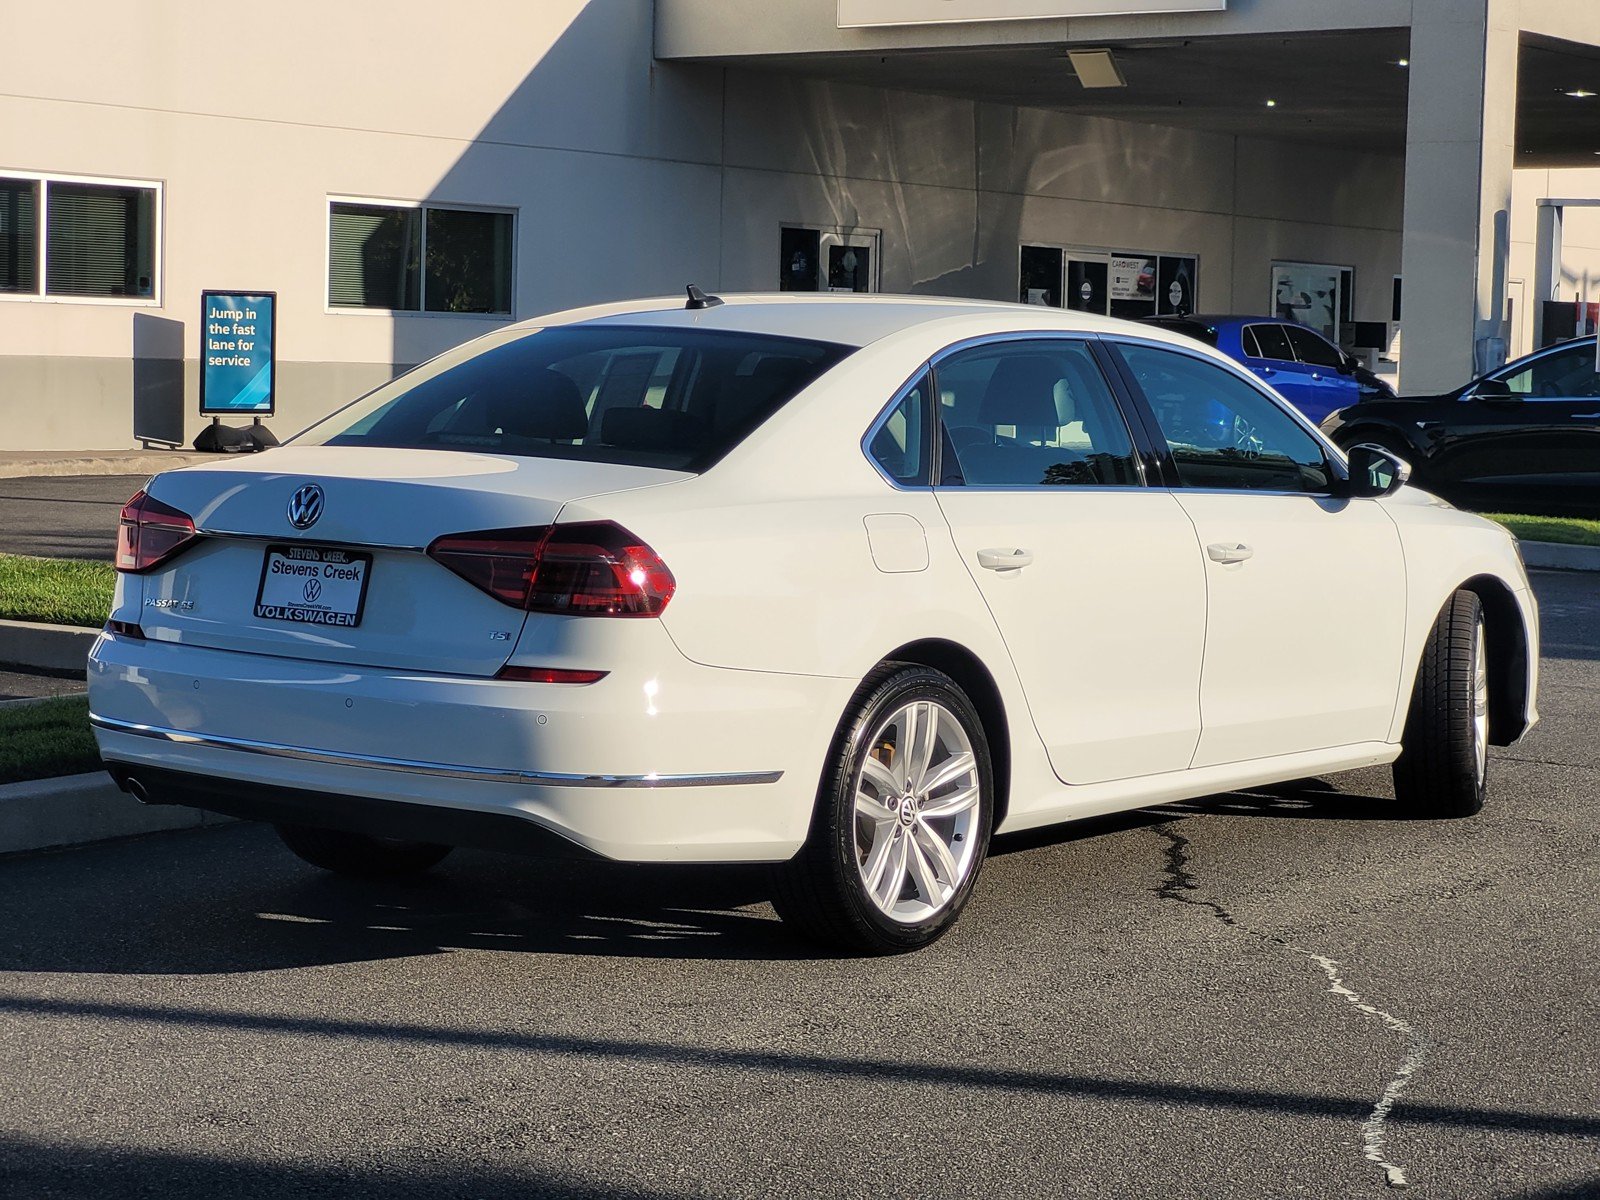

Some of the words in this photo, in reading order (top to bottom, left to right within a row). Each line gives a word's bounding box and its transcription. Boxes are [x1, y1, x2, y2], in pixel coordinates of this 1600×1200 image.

[209, 307, 244, 322] Jump
[246, 308, 257, 320] in
[209, 323, 230, 335] the
[232, 324, 256, 336] fast
[209, 338, 235, 350] lane
[237, 339, 254, 351] for
[208, 354, 251, 366] service
[289, 548, 320, 560] STEVENS
[271, 560, 319, 577] Stevens
[323, 564, 360, 581] Creek
[145, 598, 179, 608] PASSAT
[257, 605, 356, 626] VOLKSWAGEN
[489, 631, 511, 641] TSI
